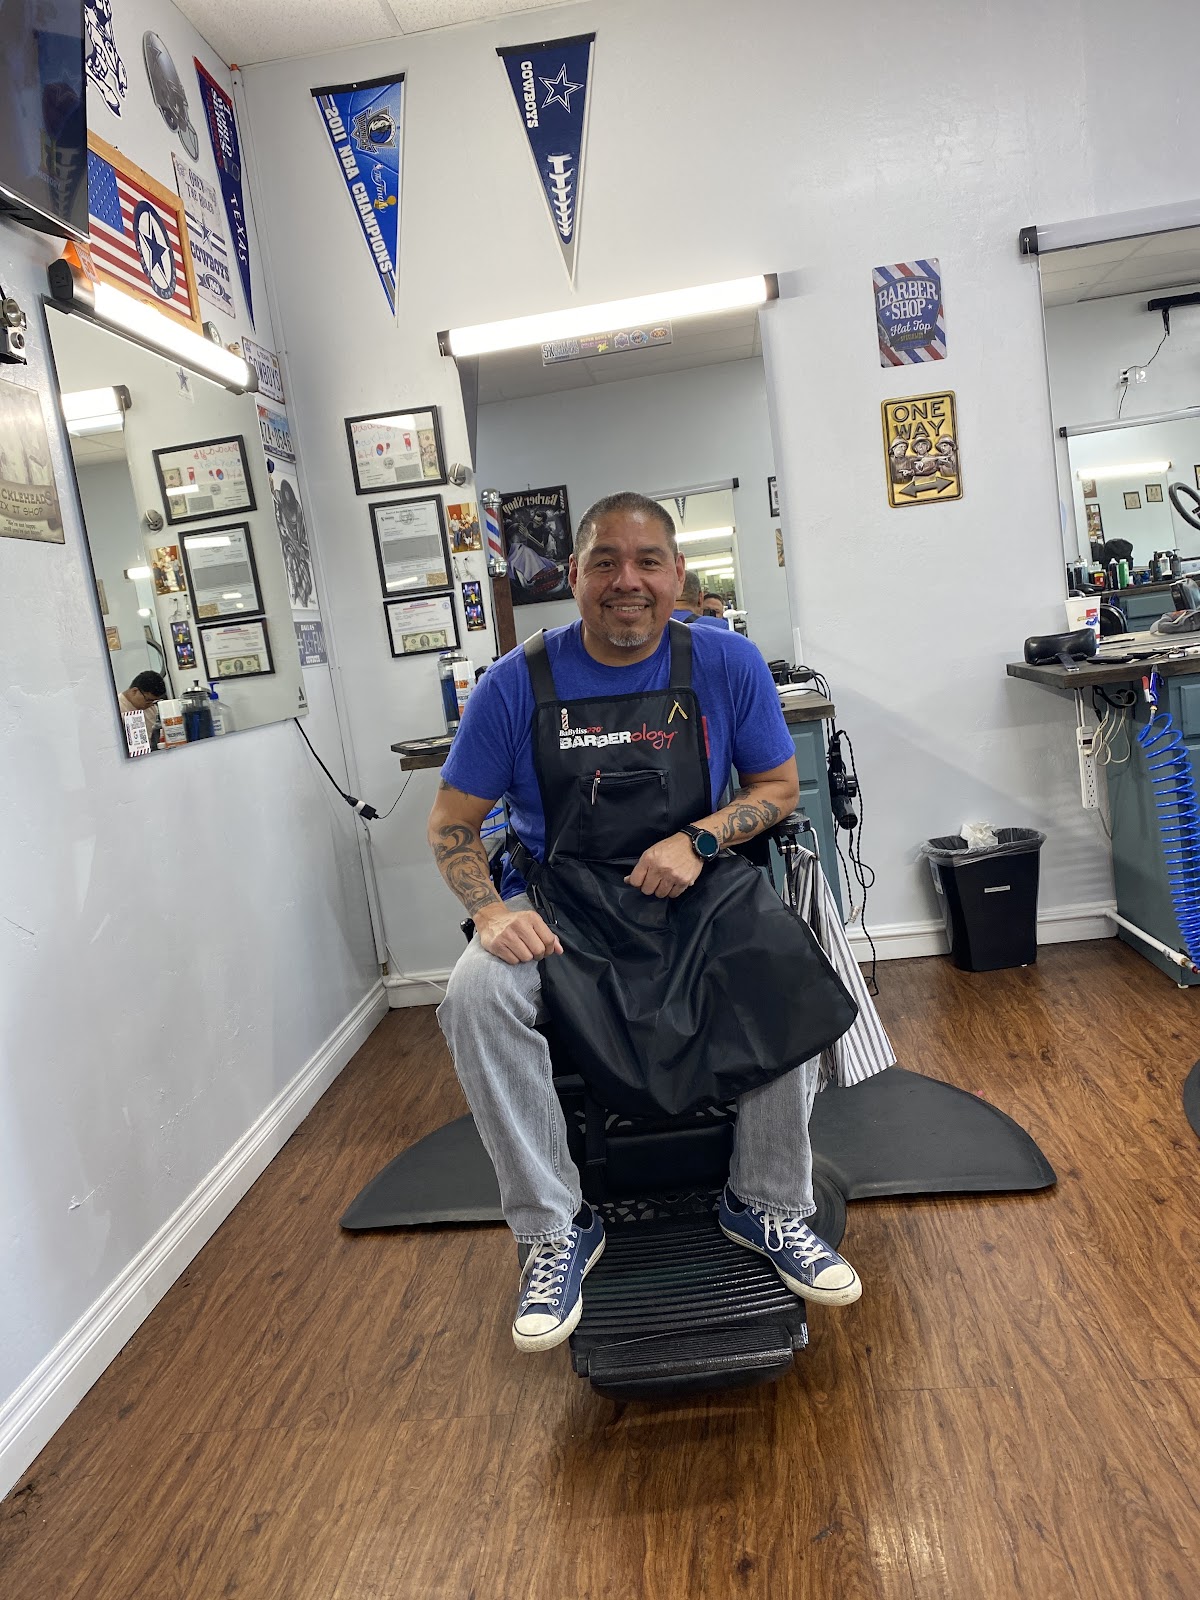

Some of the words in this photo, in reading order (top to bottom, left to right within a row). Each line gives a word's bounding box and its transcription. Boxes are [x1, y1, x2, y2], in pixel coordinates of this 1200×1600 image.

[520, 60, 538, 129] COWBOYS
[325, 106, 347, 143] 2011
[338, 144, 360, 180] NBA
[351, 181, 393, 275] CHAMPIONS
[230, 193, 247, 266] TEXAS
[189, 239, 230, 283] COWBOYS
[877, 280, 939, 309] BARBER
[890, 299, 926, 321] SHOP
[912, 319, 932, 334] Top
[891, 400, 946, 423] ONE
[893, 419, 945, 441] WAY
[0, 500, 10, 512] IX
[12, 504, 21, 514] IT
[23, 507, 44, 516] SHOP
[1, 488, 53, 506] CKLEHEADS
